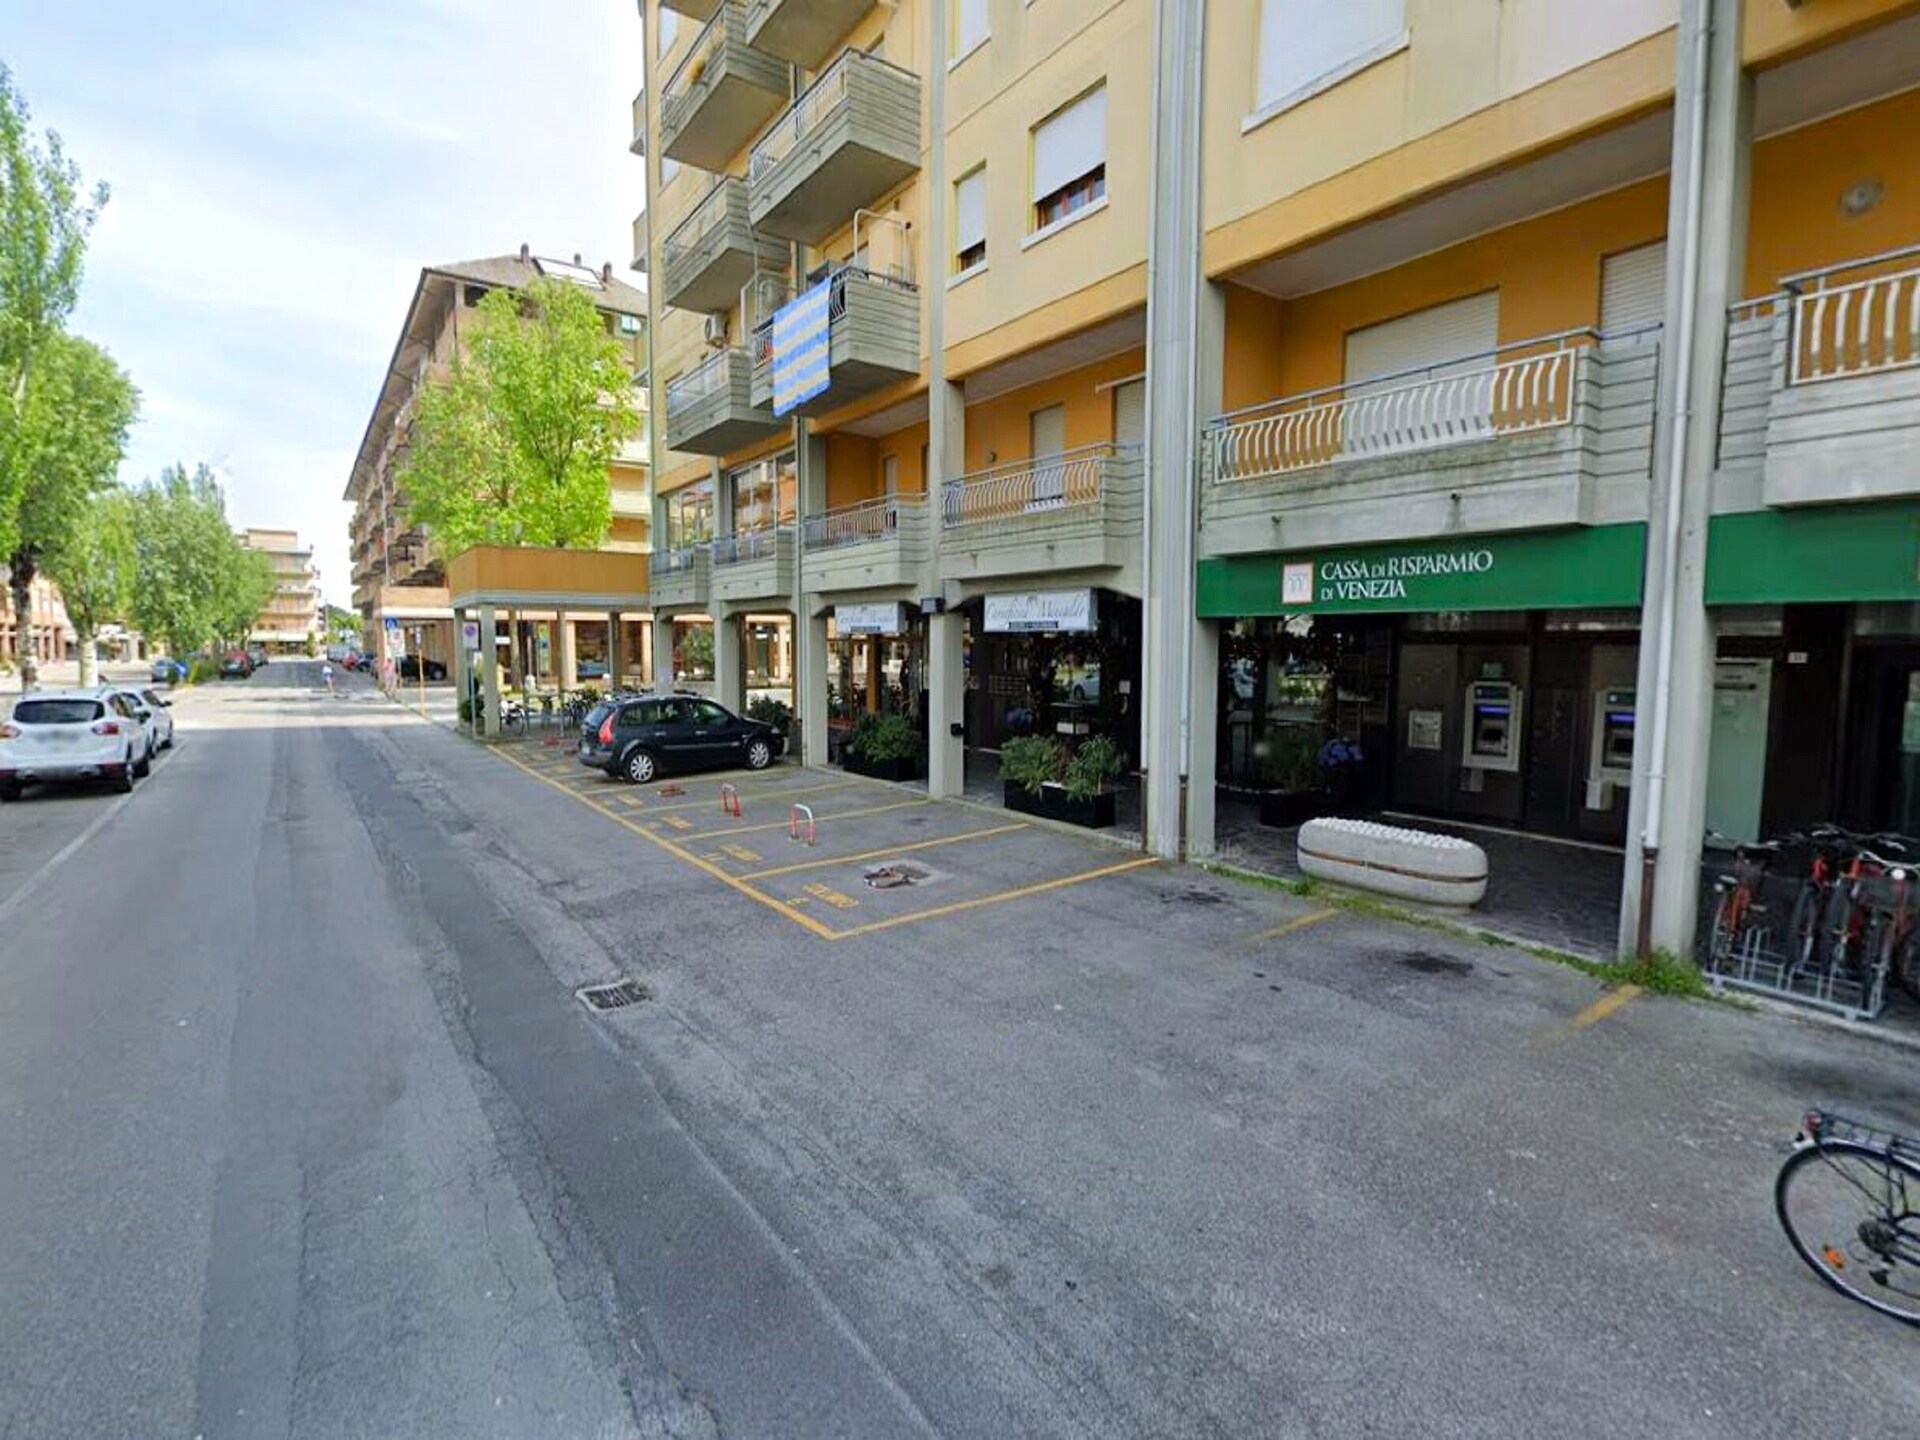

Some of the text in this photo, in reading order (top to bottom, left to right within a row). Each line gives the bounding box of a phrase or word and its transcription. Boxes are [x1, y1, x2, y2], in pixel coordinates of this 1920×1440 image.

[1320, 550, 1494, 581] CASSA DI RISPARMIO
[1320, 579, 1407, 601] DI VENEZIA
